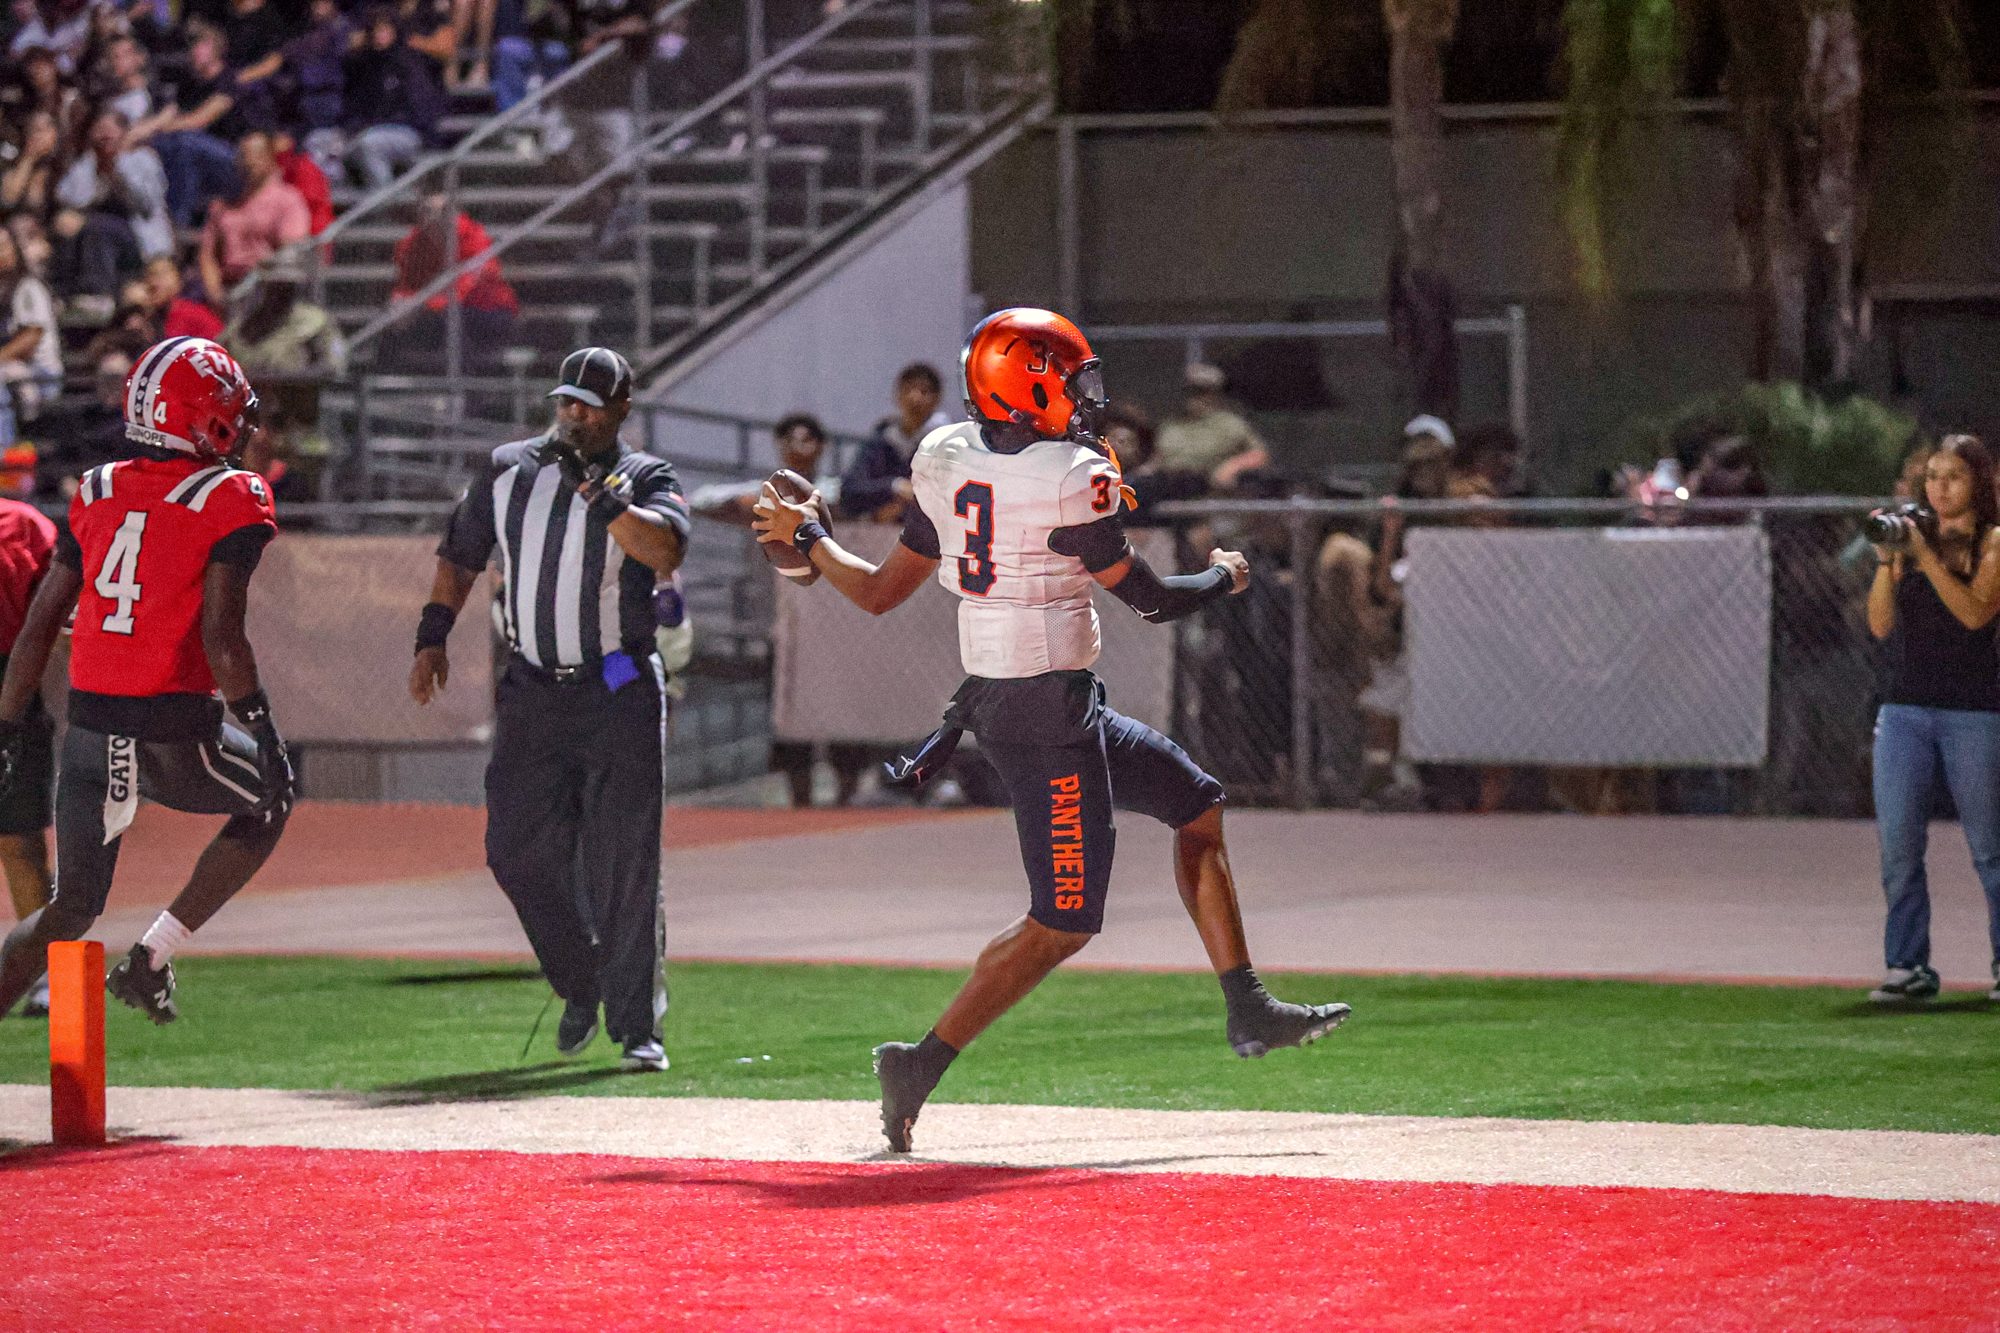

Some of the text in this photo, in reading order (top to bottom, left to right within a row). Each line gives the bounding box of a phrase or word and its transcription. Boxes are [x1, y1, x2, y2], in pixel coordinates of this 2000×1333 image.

[154, 401, 167, 424] 4
[954, 479, 997, 597] 3
[1091, 473, 1112, 513] 3
[94, 511, 148, 635] 4
[110, 737, 131, 803] GATO
[1050, 773, 1084, 910] PANTHERS
